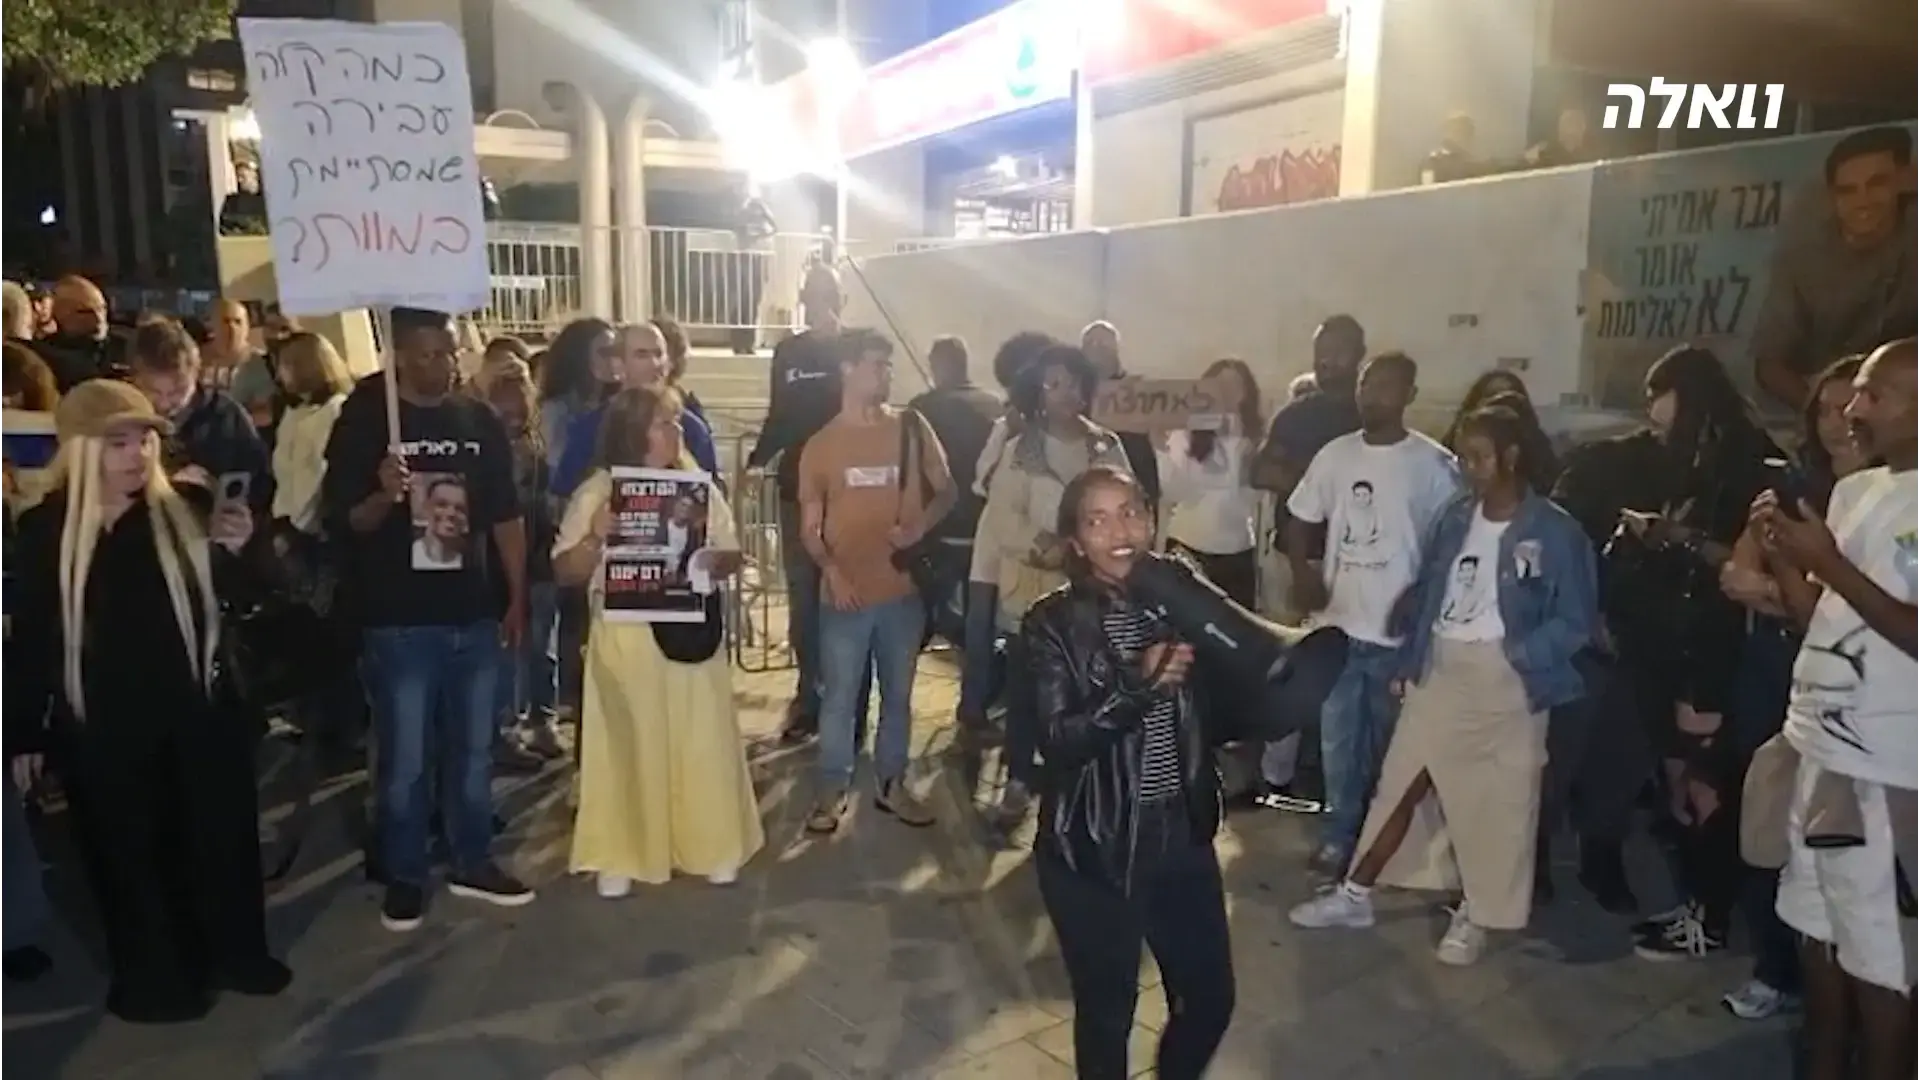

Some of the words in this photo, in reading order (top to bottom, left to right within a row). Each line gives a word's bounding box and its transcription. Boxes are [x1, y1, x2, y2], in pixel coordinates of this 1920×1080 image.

[335, 48, 446, 83] כמה
[292, 97, 452, 137] עבירה
[1641, 188, 1720, 238] אמיתי
[1731, 180, 1782, 230] גבר
[276, 211, 470, 272] במוות?
[1635, 243, 1698, 288] אומר
[1597, 290, 1692, 339] לאלימות
[1695, 264, 1752, 335] לא
[1171, 383, 1214, 411] לא
